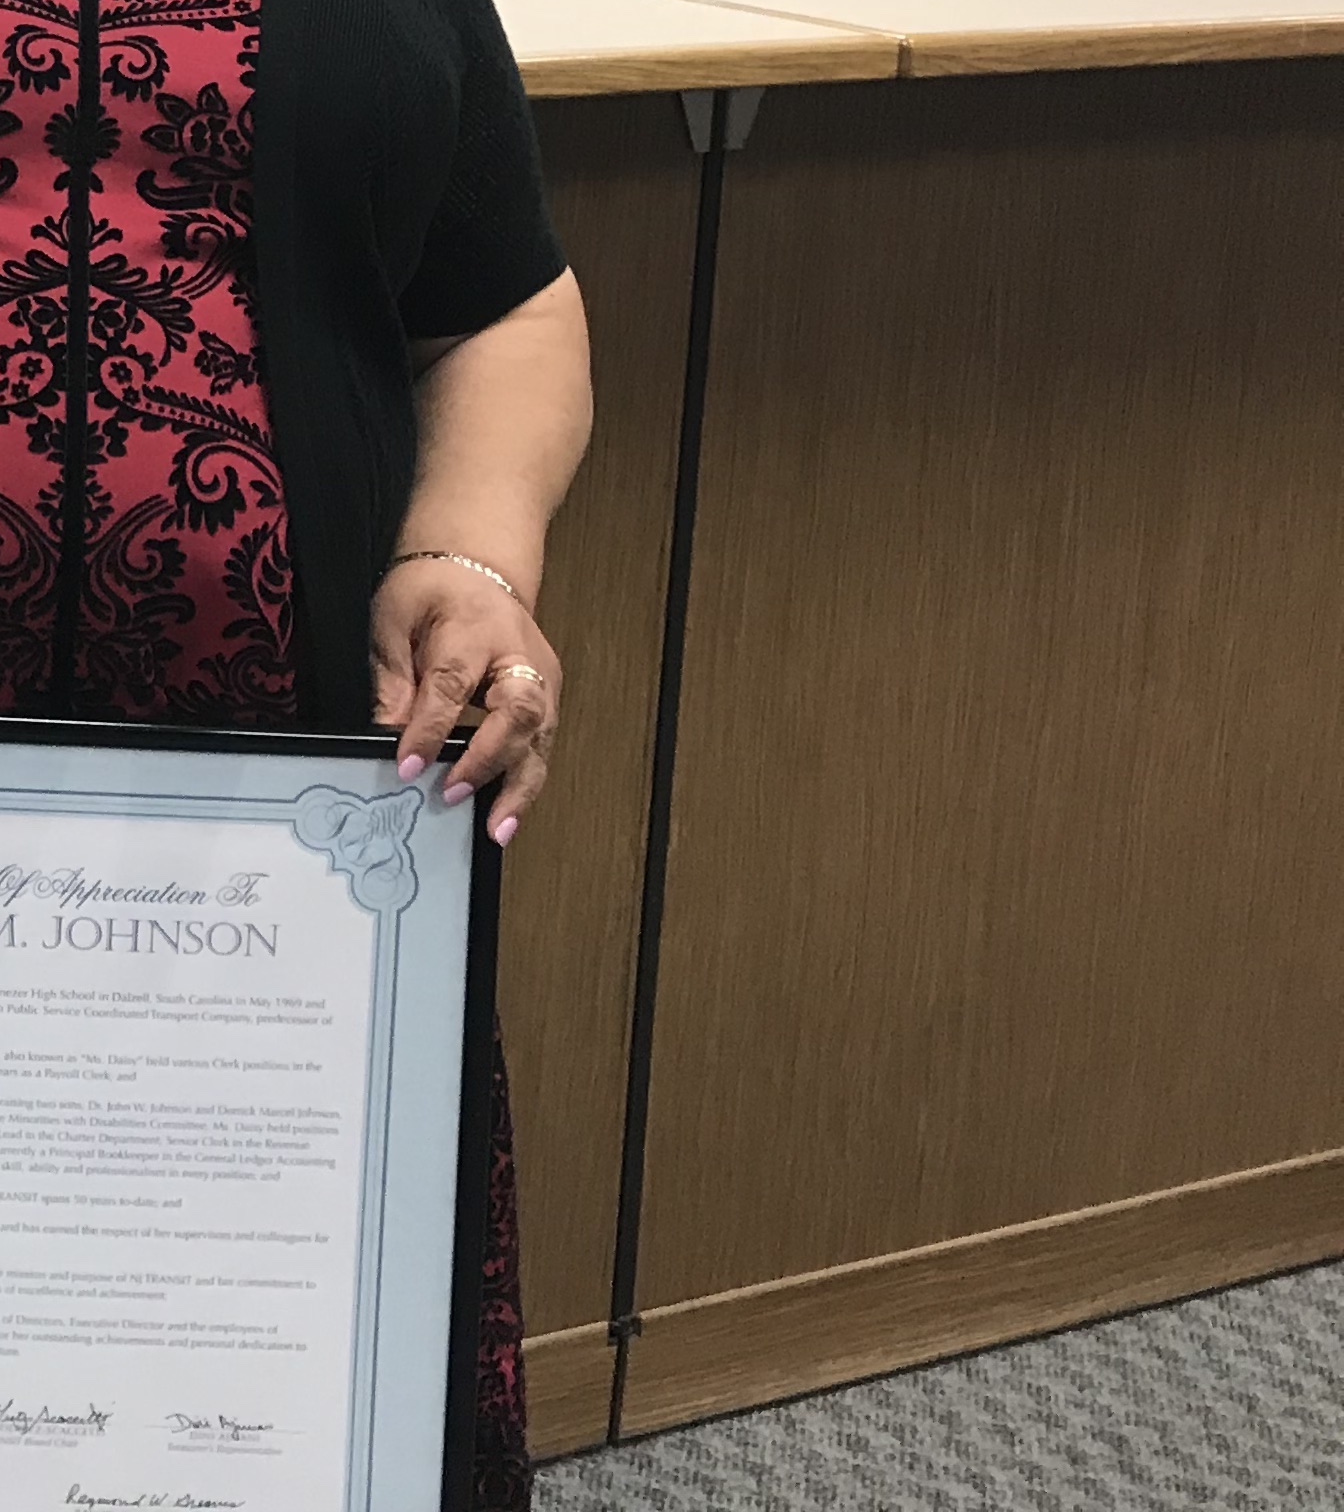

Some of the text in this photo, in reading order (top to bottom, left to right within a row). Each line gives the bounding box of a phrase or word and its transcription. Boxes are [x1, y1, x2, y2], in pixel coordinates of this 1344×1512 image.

[32, 867, 208, 909] Appreciation
[216, 872, 270, 907] To
[41, 915, 282, 957] JOHNSON
[305, 999, 326, 1010] and
[116, 1071, 137, 1082] and
[194, 1104, 215, 1116] and
[161, 1198, 182, 1209] and
